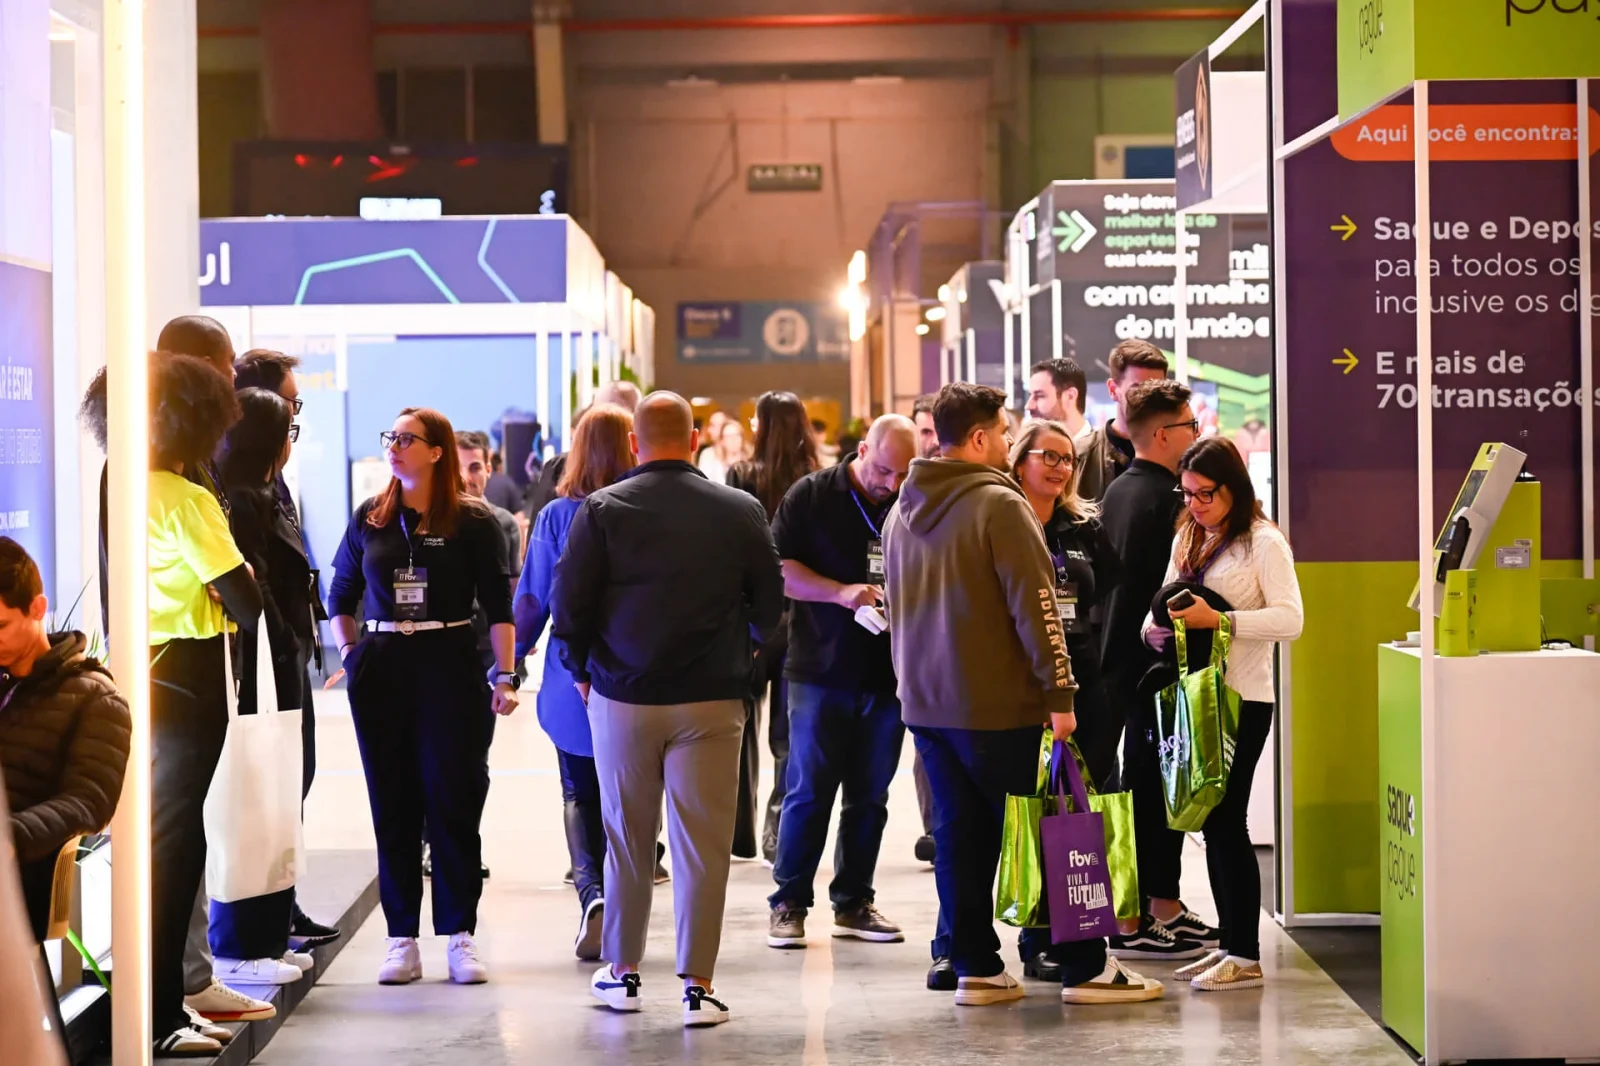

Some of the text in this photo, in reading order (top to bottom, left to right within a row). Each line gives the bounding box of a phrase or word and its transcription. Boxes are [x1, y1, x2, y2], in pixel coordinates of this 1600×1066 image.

[1356, 124, 1578, 145] Aqui ocê encontra:
[1104, 213, 1217, 228] melhor loa de
[1480, 220, 1498, 240] e
[1104, 233, 1176, 251] esportes
[1451, 252, 1538, 277] todos
[1549, 258, 1581, 276] os
[1084, 284, 1148, 307] com
[1376, 290, 1505, 314] incusive
[1515, 294, 1549, 313] os
[1115, 313, 1153, 340] do
[1153, 312, 1254, 339] mundo
[1376, 352, 1395, 374] E
[1487, 350, 1524, 374] de
[1376, 383, 1418, 409] 70
[1037, 588, 1069, 688] ADVENTURE
[1387, 783, 1415, 841] saque
[1068, 850, 1091, 868] fbv
[1387, 840, 1415, 900] pague
[1066, 873, 1083, 887] VIVA
